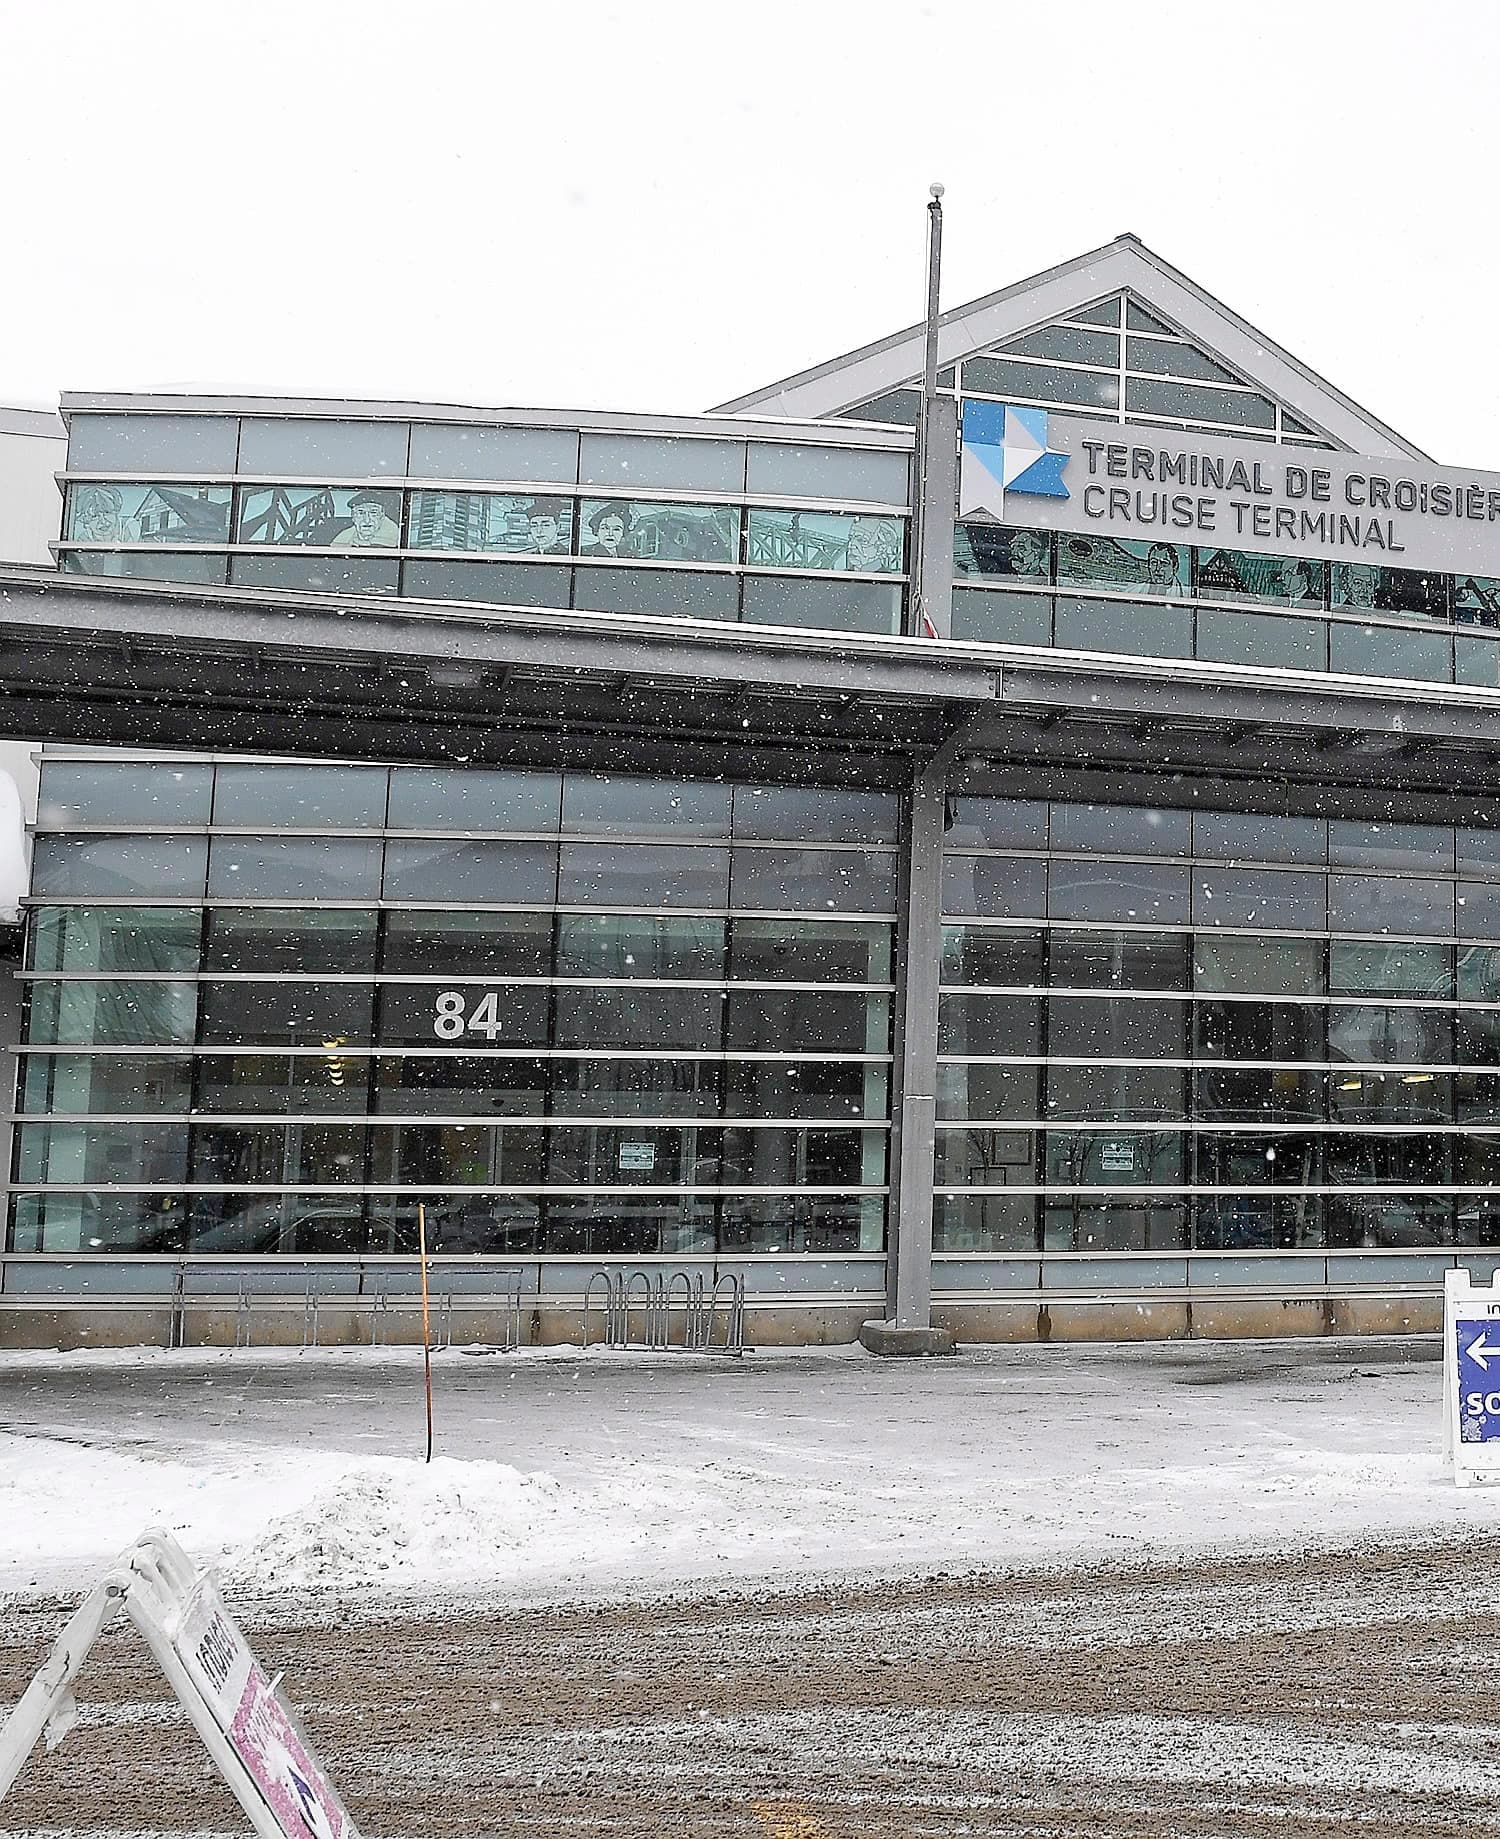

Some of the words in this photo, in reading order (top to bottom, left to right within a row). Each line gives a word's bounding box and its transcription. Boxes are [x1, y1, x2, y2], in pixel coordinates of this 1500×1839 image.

[1081, 438, 1273, 495] TERMINAL
[1285, 463, 1331, 502] DE
[1083, 482, 1217, 531] CRUISE
[1229, 500, 1406, 552] TERMINAL
[433, 991, 502, 1040] 84
